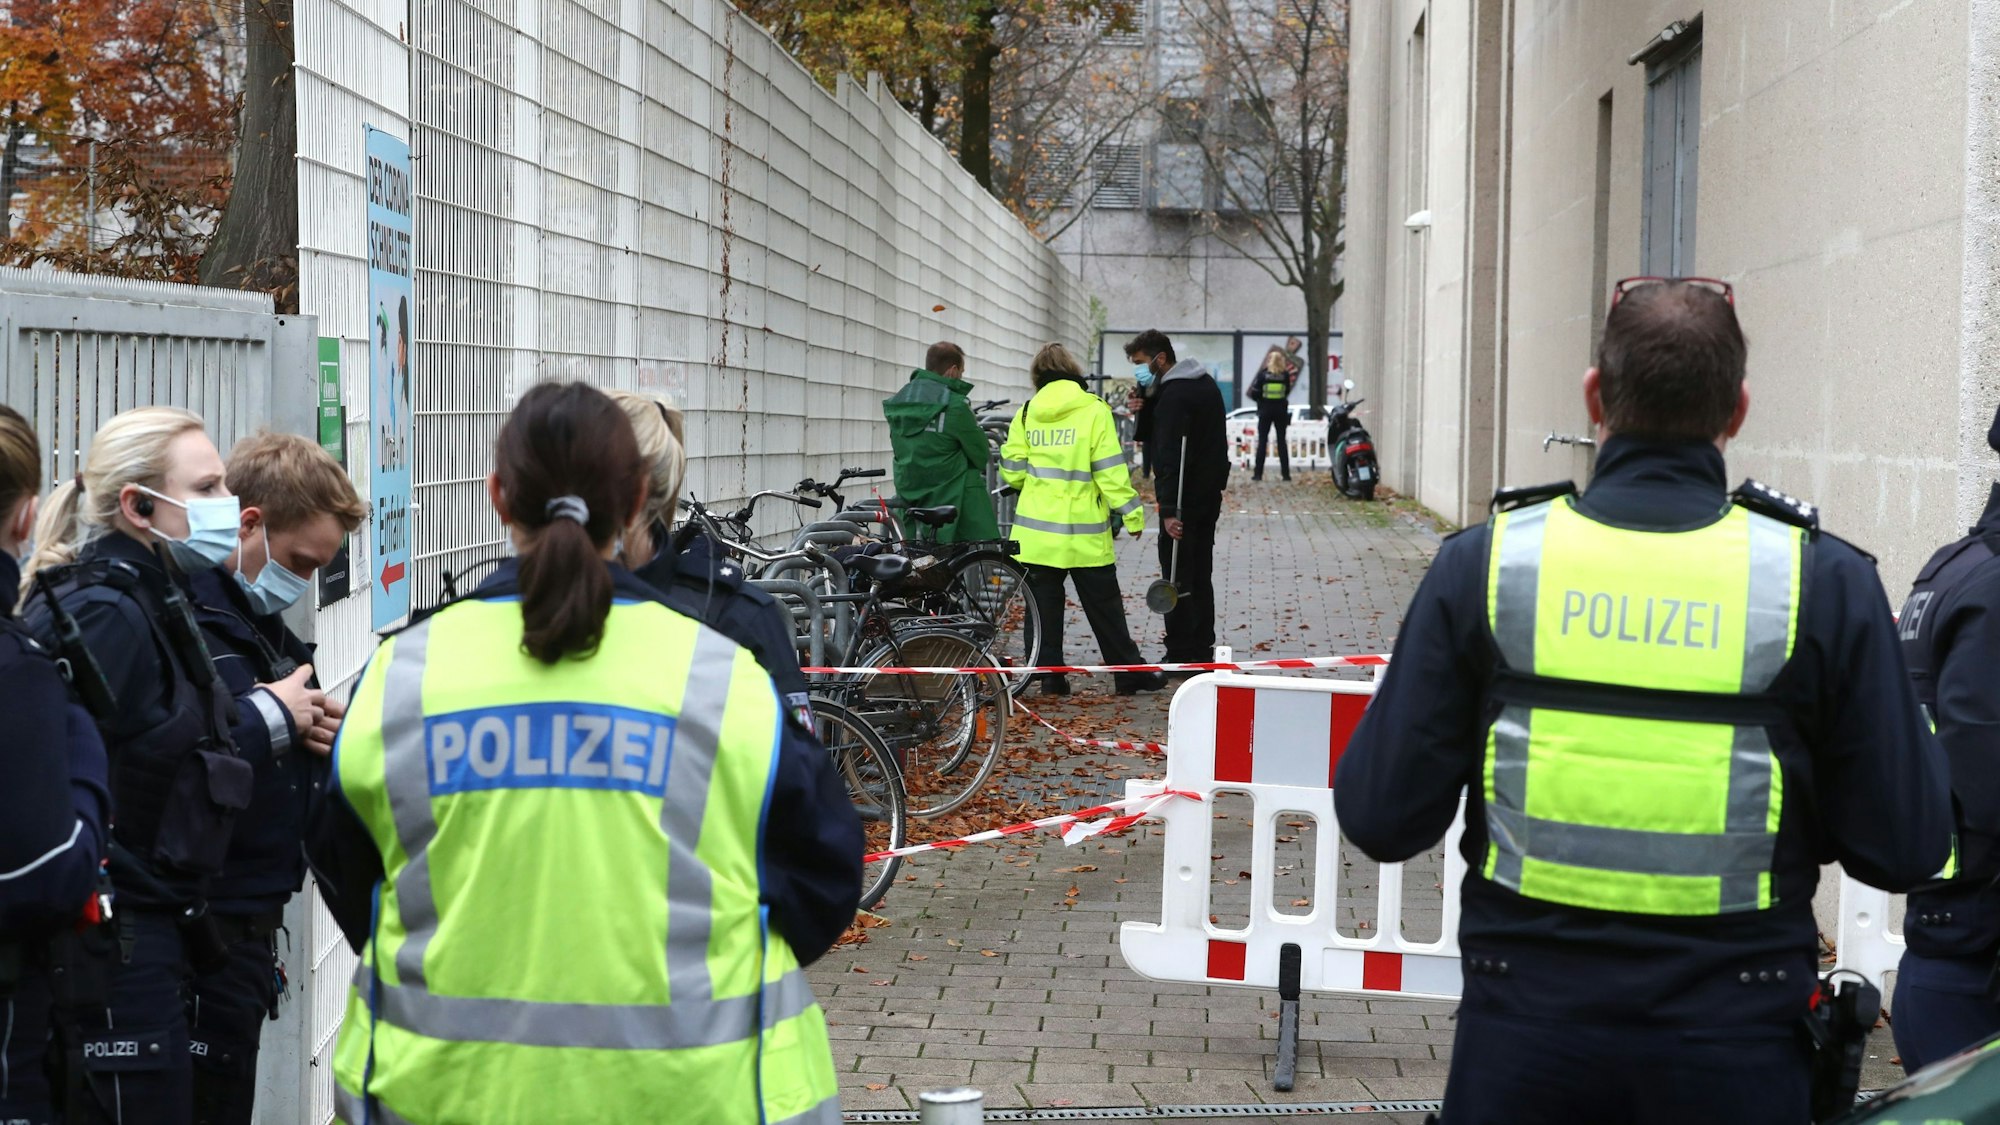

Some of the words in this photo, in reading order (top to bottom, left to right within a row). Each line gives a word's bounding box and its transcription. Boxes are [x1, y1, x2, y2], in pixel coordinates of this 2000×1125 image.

[368, 155, 384, 207] DER
[384, 162, 411, 218] CORONA
[370, 220, 411, 278] SCHNELLTEST
[1026, 428, 1076, 447] POLIZEI
[379, 494, 406, 556] Einfahrt
[1561, 590, 1721, 650] POLIZEI
[1897, 591, 1934, 641] IZEI
[431, 714, 671, 787] POLIZEI
[83, 1041, 138, 1058] POLIZEI
